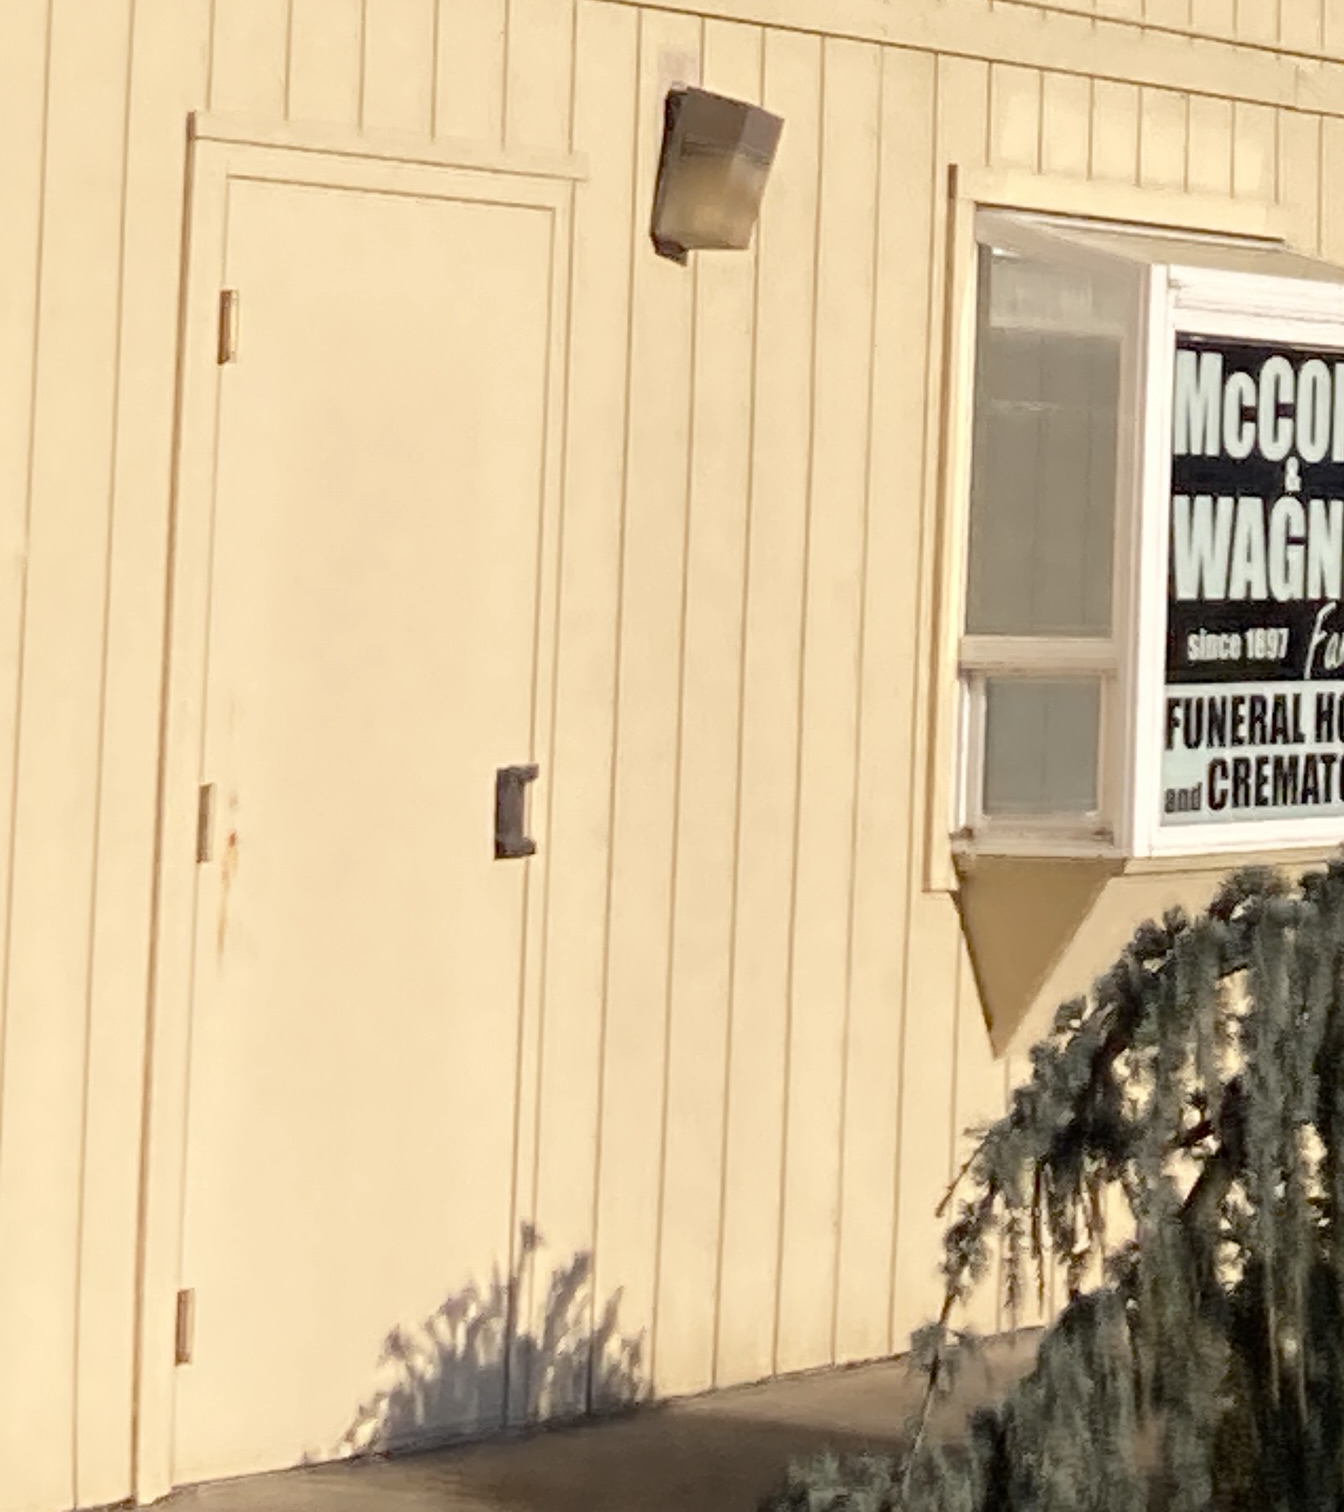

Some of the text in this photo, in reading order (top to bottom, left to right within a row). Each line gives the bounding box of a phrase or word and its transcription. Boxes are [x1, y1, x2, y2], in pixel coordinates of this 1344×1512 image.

[1285, 456, 1301, 492] &
[1187, 627, 1241, 661] since
[1165, 691, 1305, 752] FUNERAL
[1164, 781, 1201, 814] and
